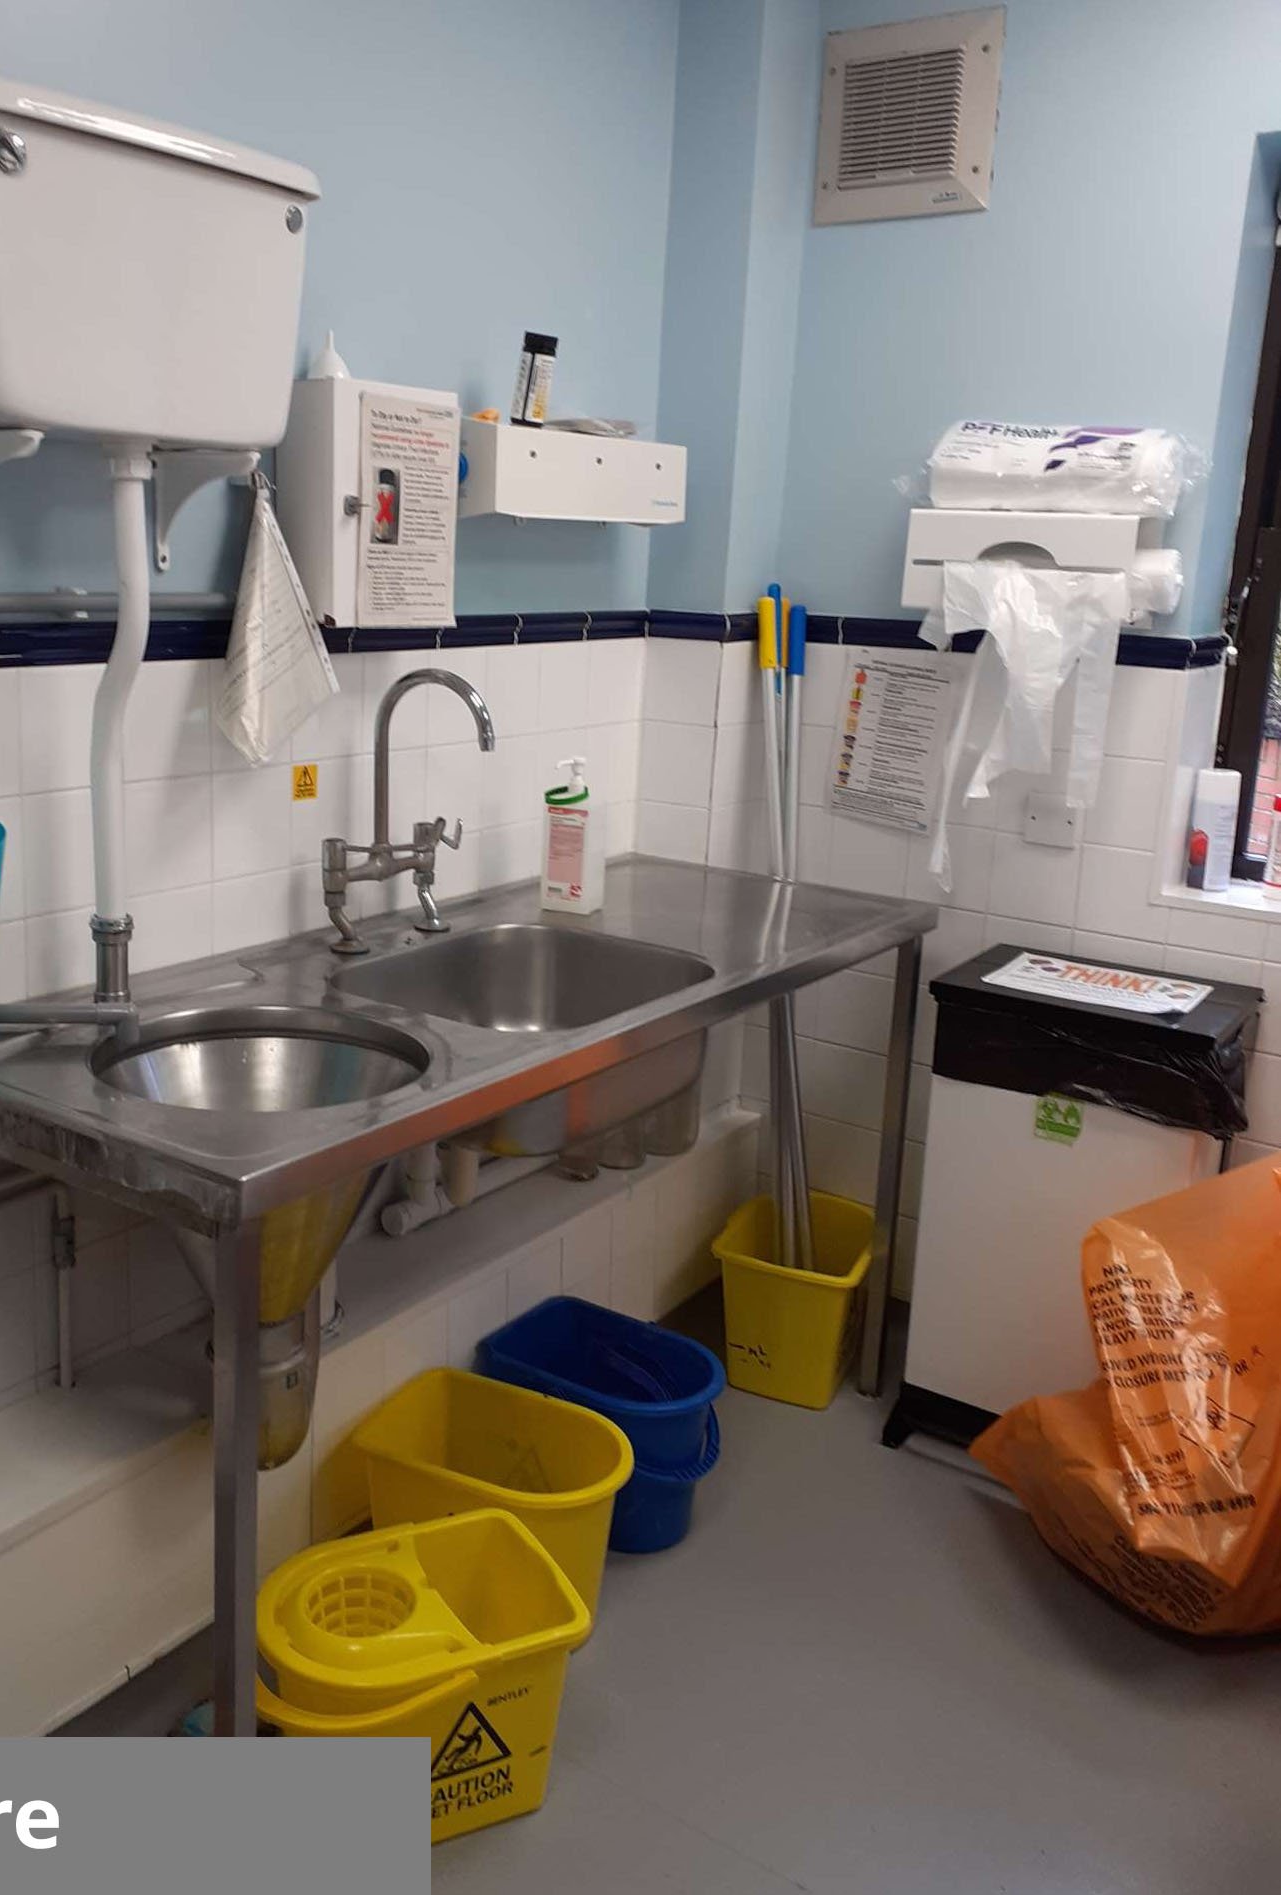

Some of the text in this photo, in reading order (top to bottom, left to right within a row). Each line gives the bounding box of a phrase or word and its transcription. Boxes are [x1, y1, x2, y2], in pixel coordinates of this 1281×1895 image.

[1058, 964, 1159, 994] THINK!
[486, 1685, 530, 1707] BENTLEY
[431, 1763, 511, 1803] AUTION
[431, 1780, 514, 1819] ET FLOOR
